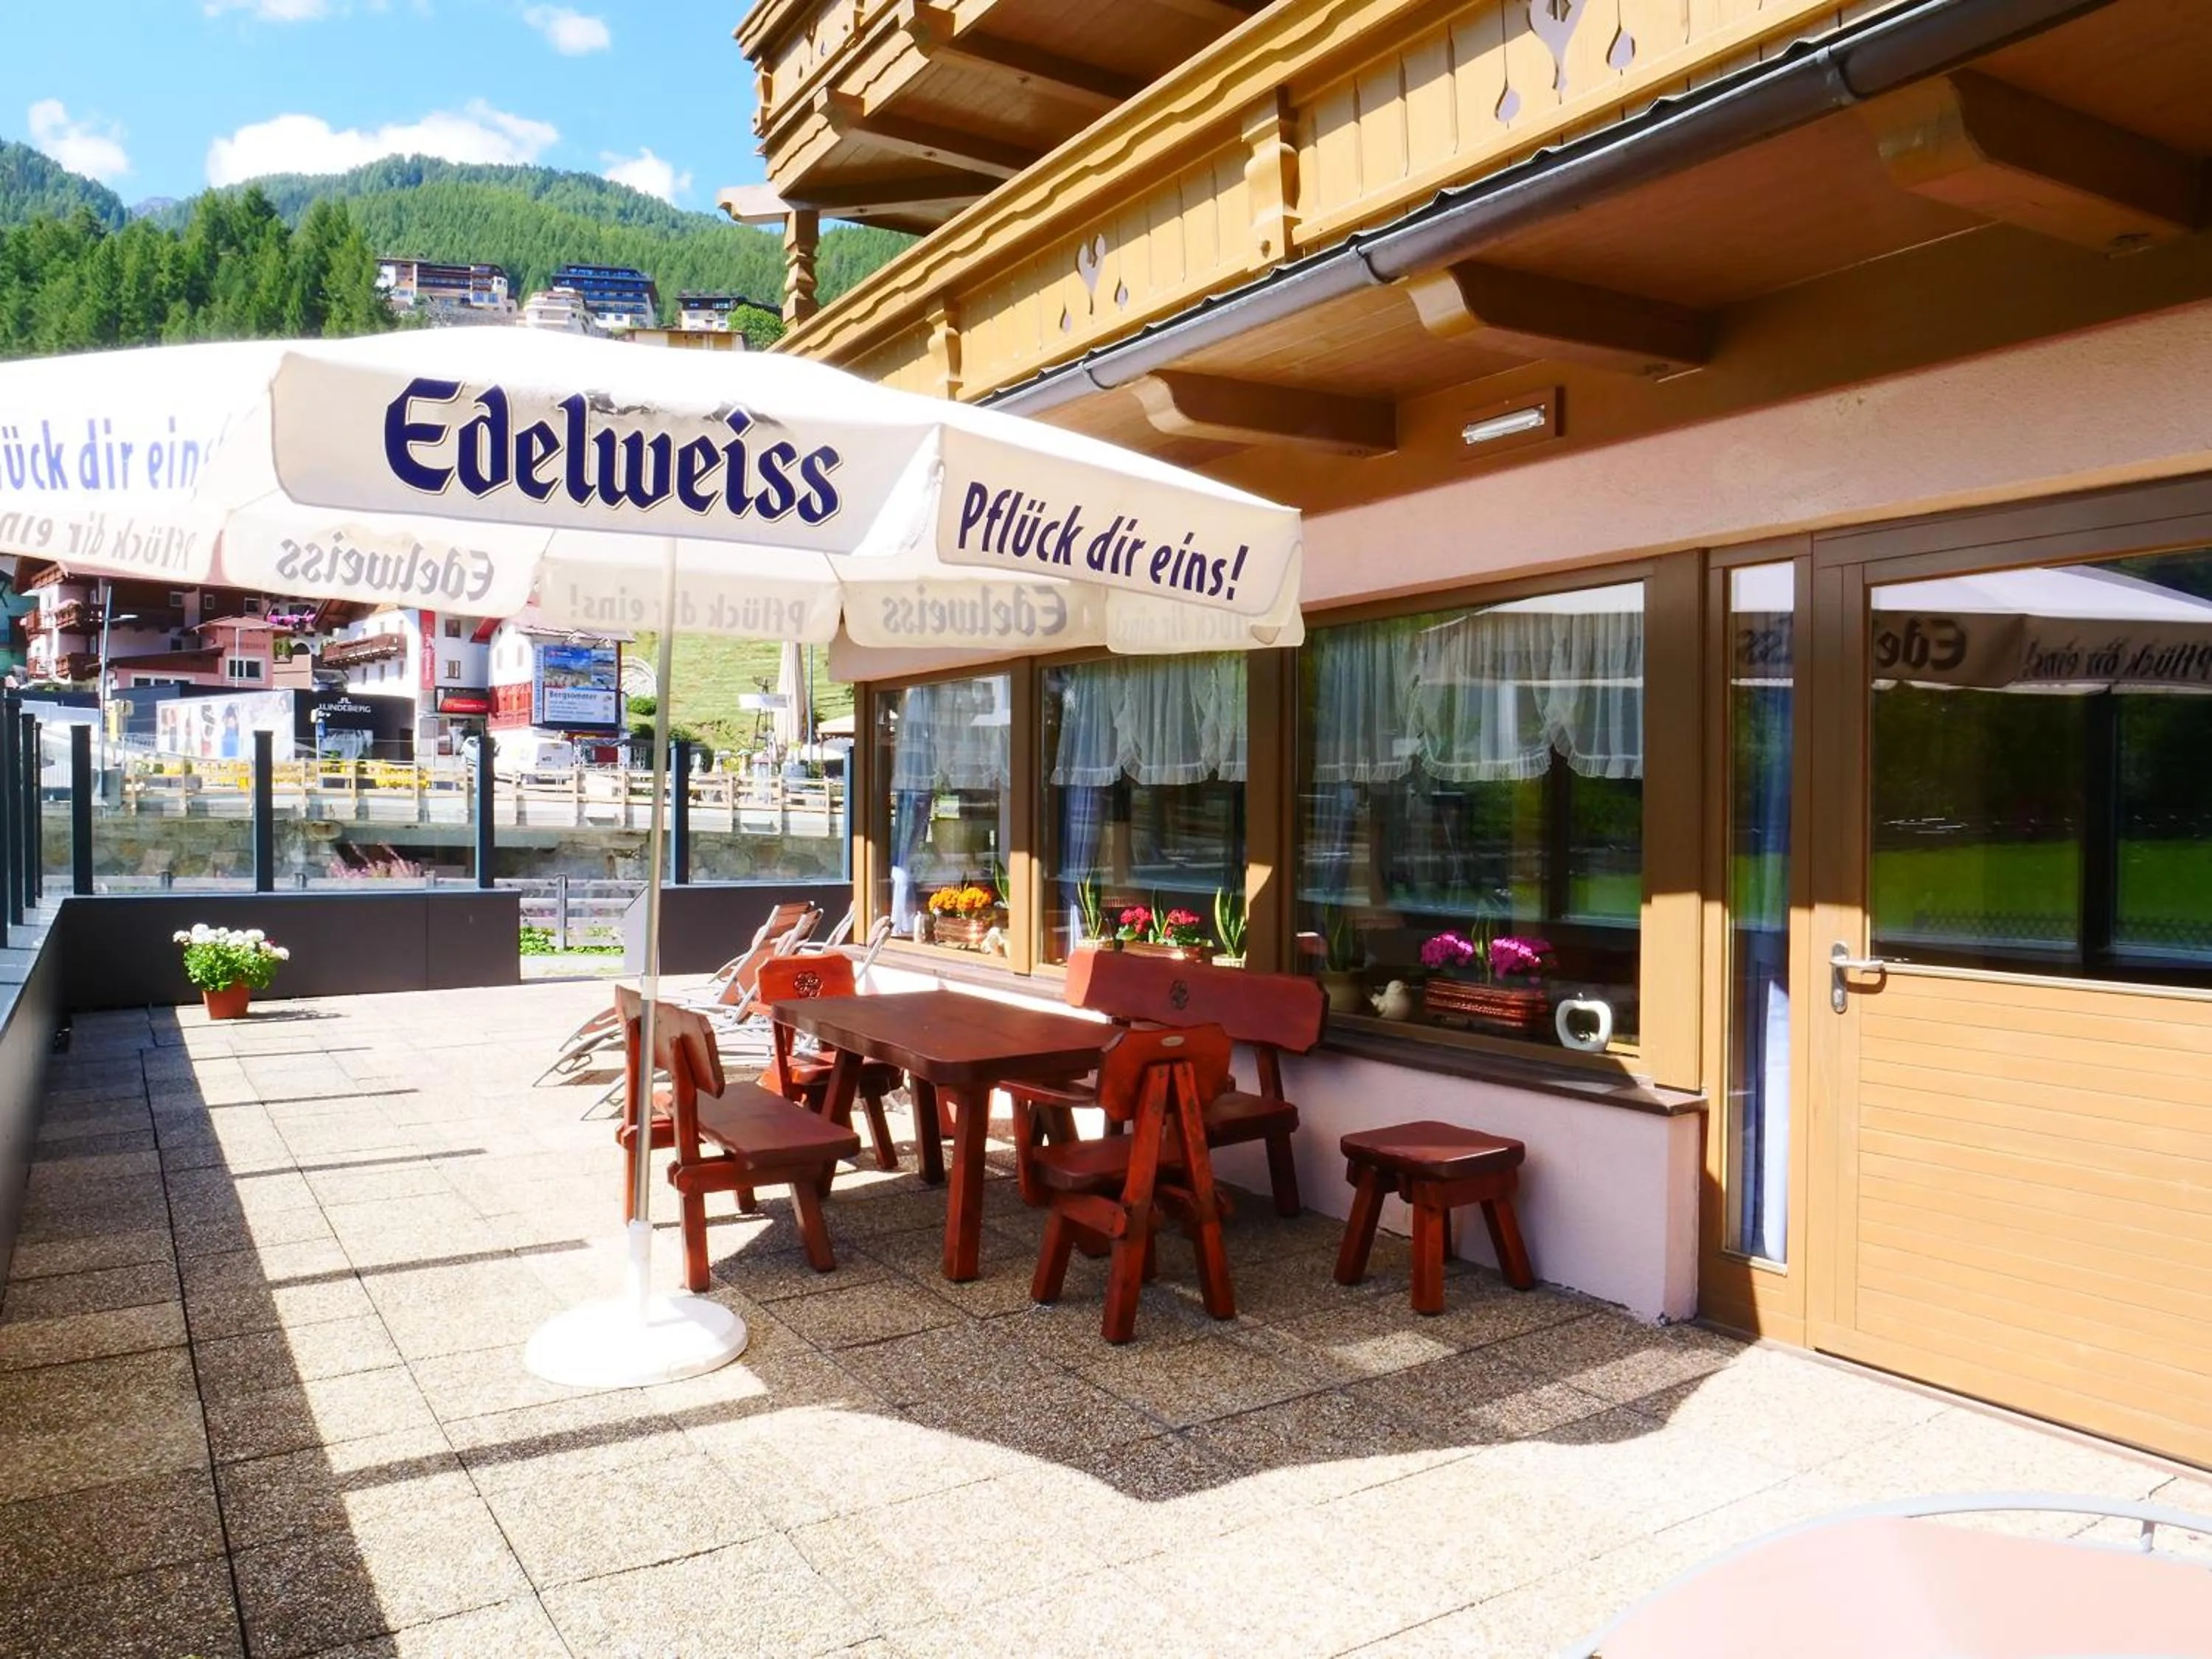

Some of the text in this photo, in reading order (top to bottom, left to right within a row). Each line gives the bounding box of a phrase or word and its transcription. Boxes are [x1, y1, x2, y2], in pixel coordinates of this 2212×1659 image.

[0, 420, 69, 490] ück
[79, 418, 133, 490] dir
[384, 377, 841, 526] Edelweiss
[958, 481, 1249, 601] Pflück dir eins!
